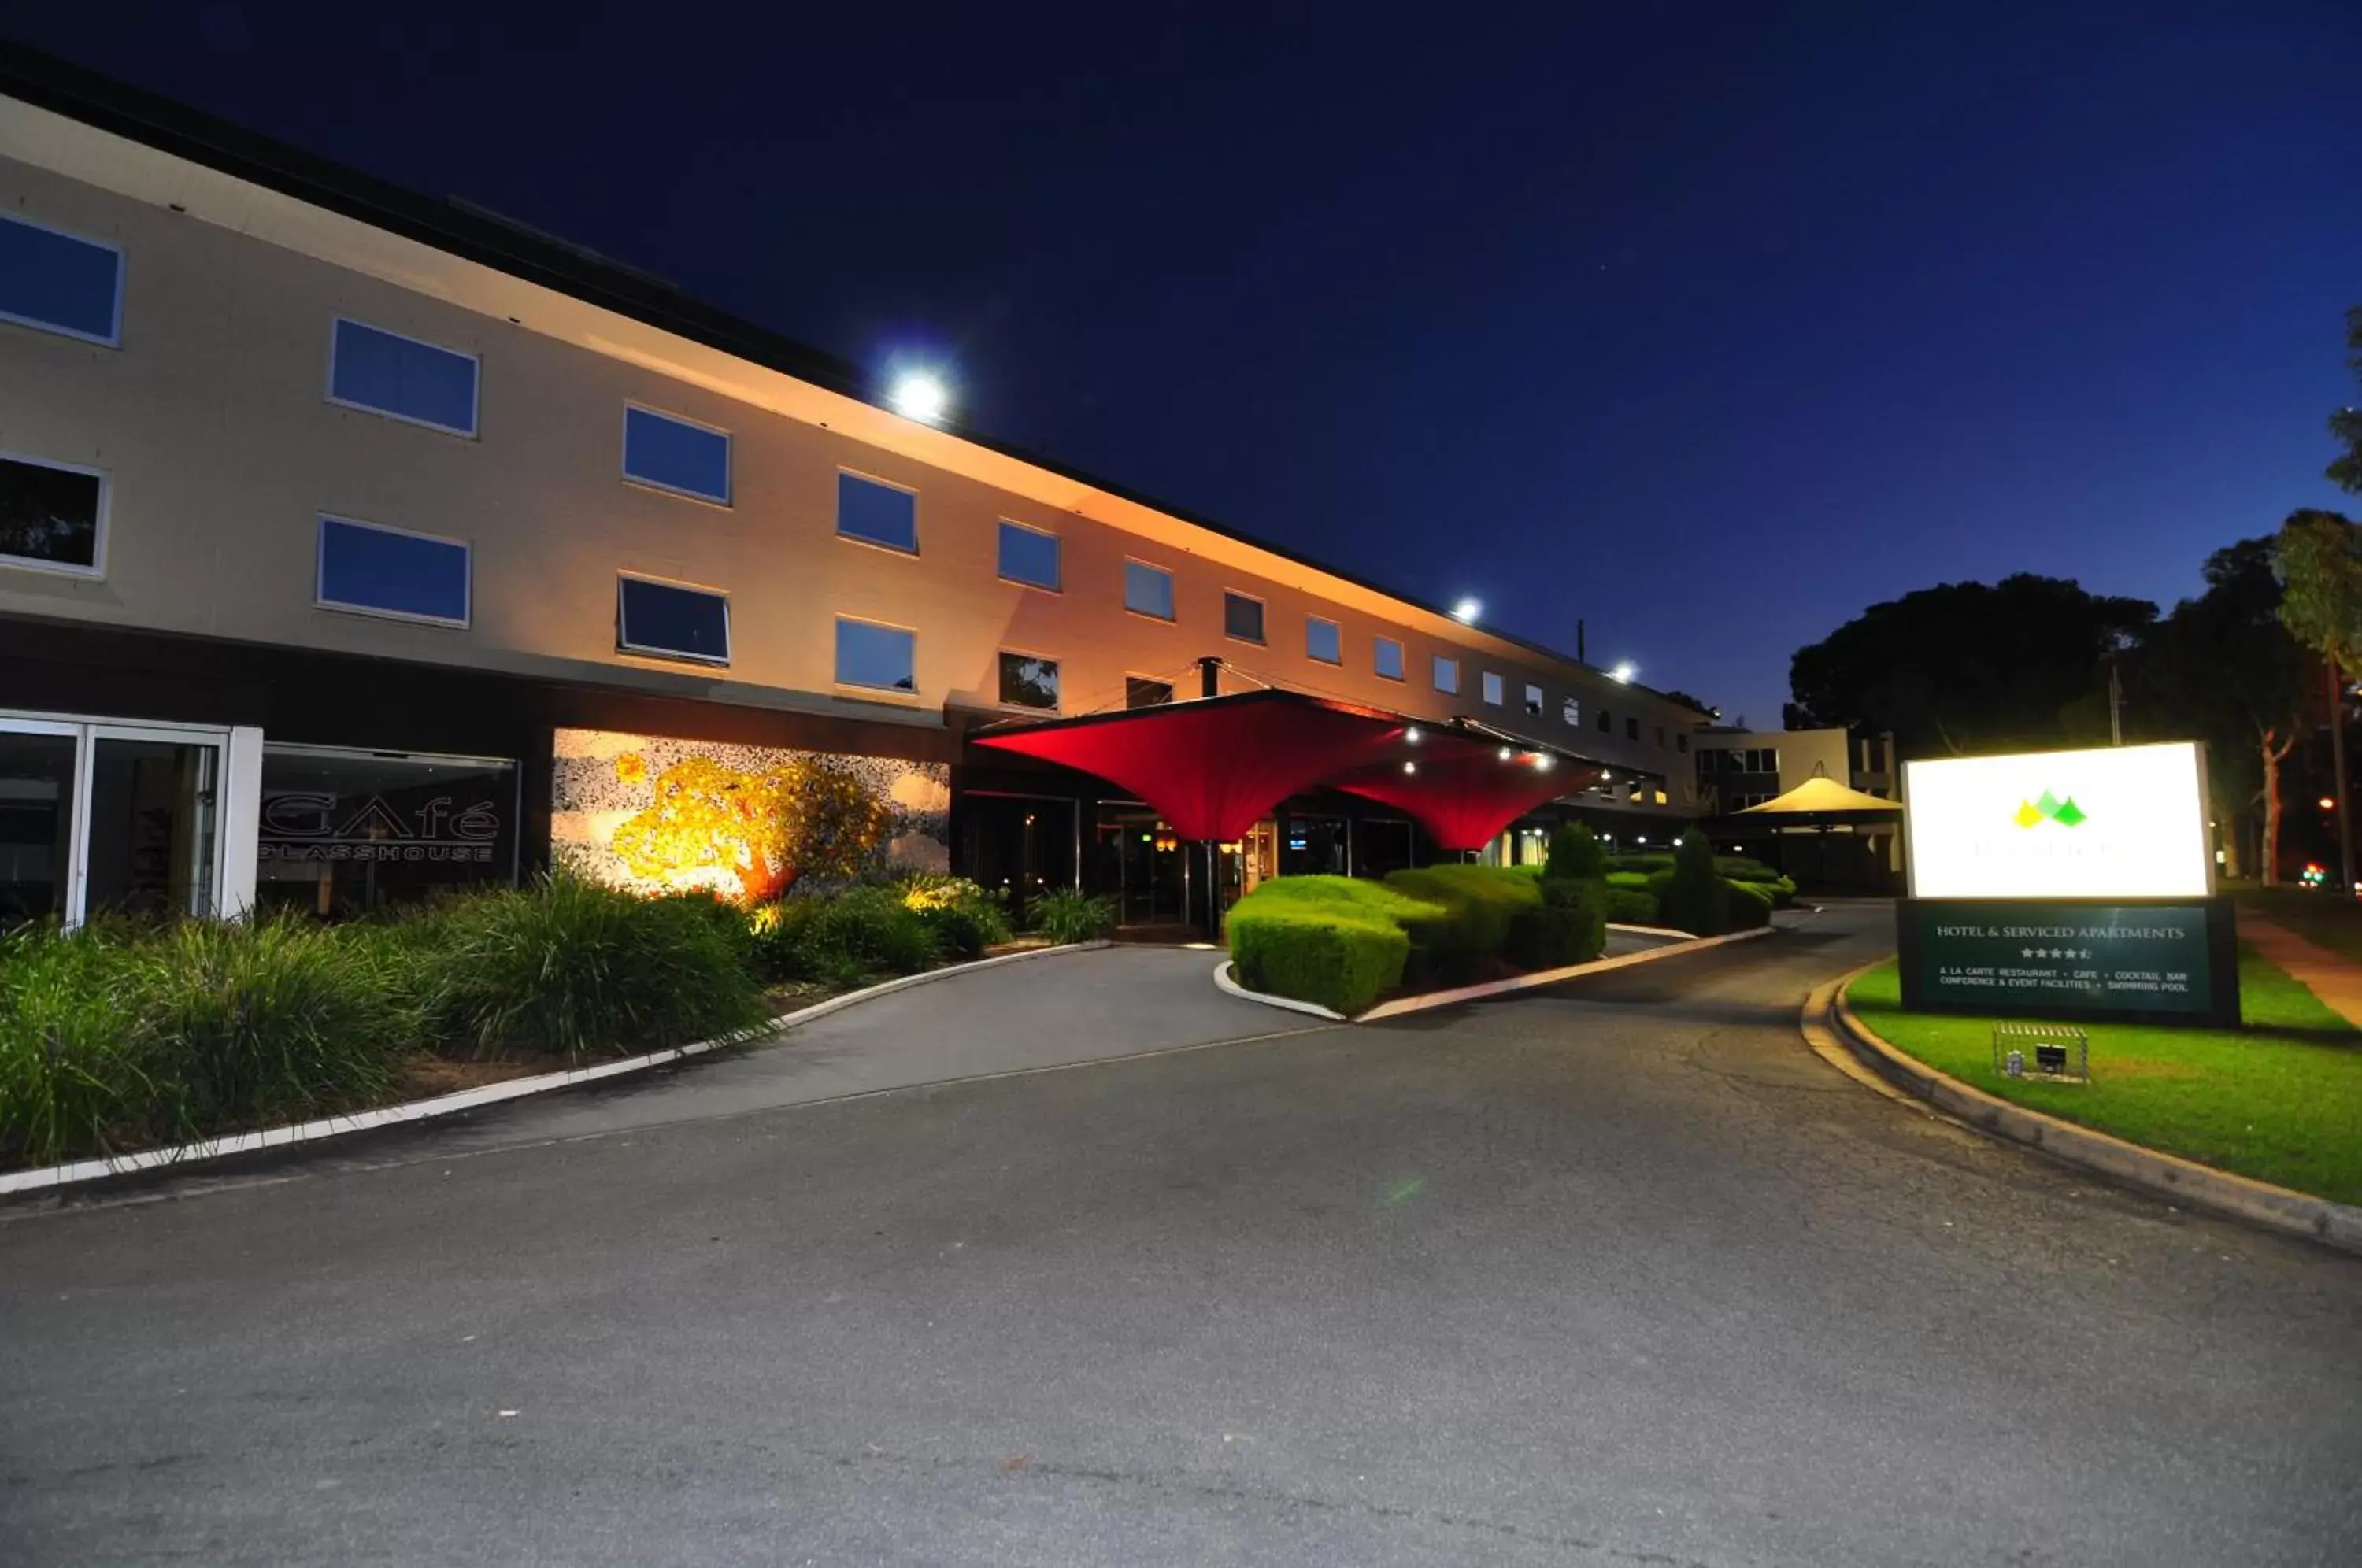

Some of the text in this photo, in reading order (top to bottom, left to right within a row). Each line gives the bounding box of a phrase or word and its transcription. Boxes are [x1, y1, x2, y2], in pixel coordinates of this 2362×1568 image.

[1937, 926, 2185, 939] HOTEL & SERVICED APARTMENTS
[1999, 968, 2057, 977] RESTAURANT
[2114, 971, 2160, 981] COCKTAIL
[2166, 972, 2186, 981] BAR
[1939, 976, 1994, 986] CONFERENCE
[2008, 978, 2038, 987] EVENT
[2041, 979, 2091, 989] FACILITIES
[2108, 981, 2159, 991] SWIMMING
[2161, 982, 2189, 993] POOL
